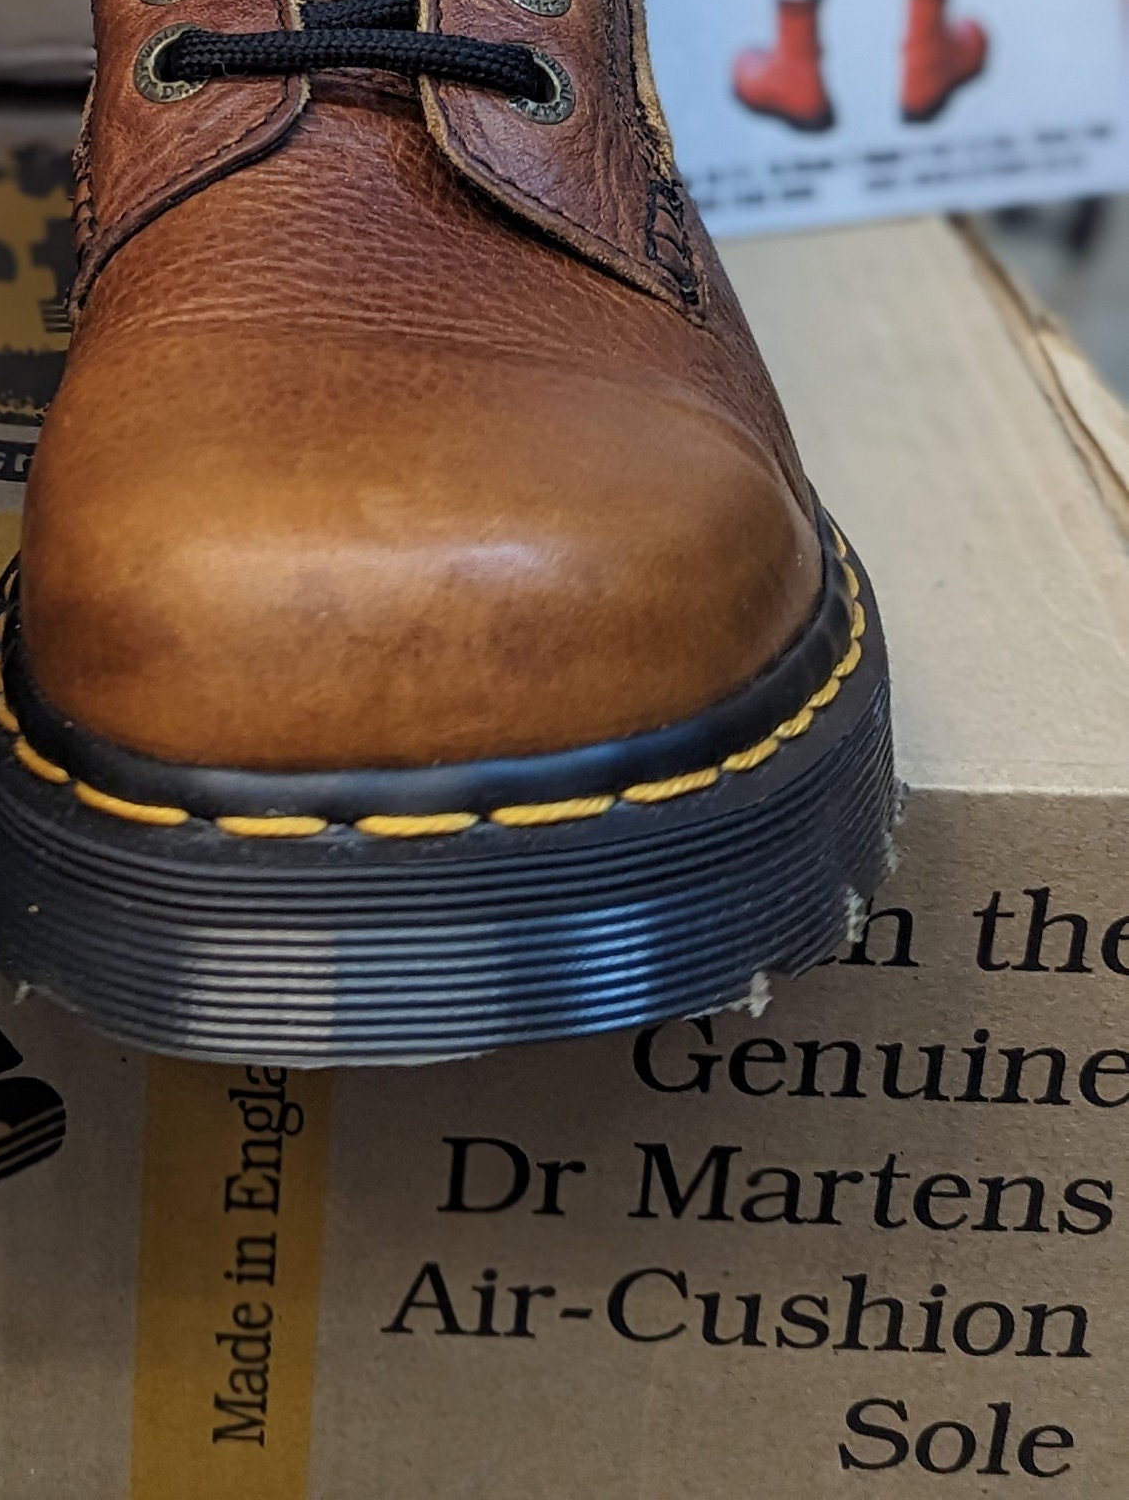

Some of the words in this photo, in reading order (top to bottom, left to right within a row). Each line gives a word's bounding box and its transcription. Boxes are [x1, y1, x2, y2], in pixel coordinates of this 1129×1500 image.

[817, 898, 920, 967] n
[631, 1017, 1129, 1108] Genuine
[222, 1064, 304, 1216] Engla
[436, 1136, 587, 1217] Dr
[627, 1141, 1114, 1236] Martens
[223, 1231, 277, 1287] in
[380, 1262, 1092, 1359] Air-Cushion
[212, 1300, 274, 1447] Made
[838, 1397, 1076, 1479] Sole
